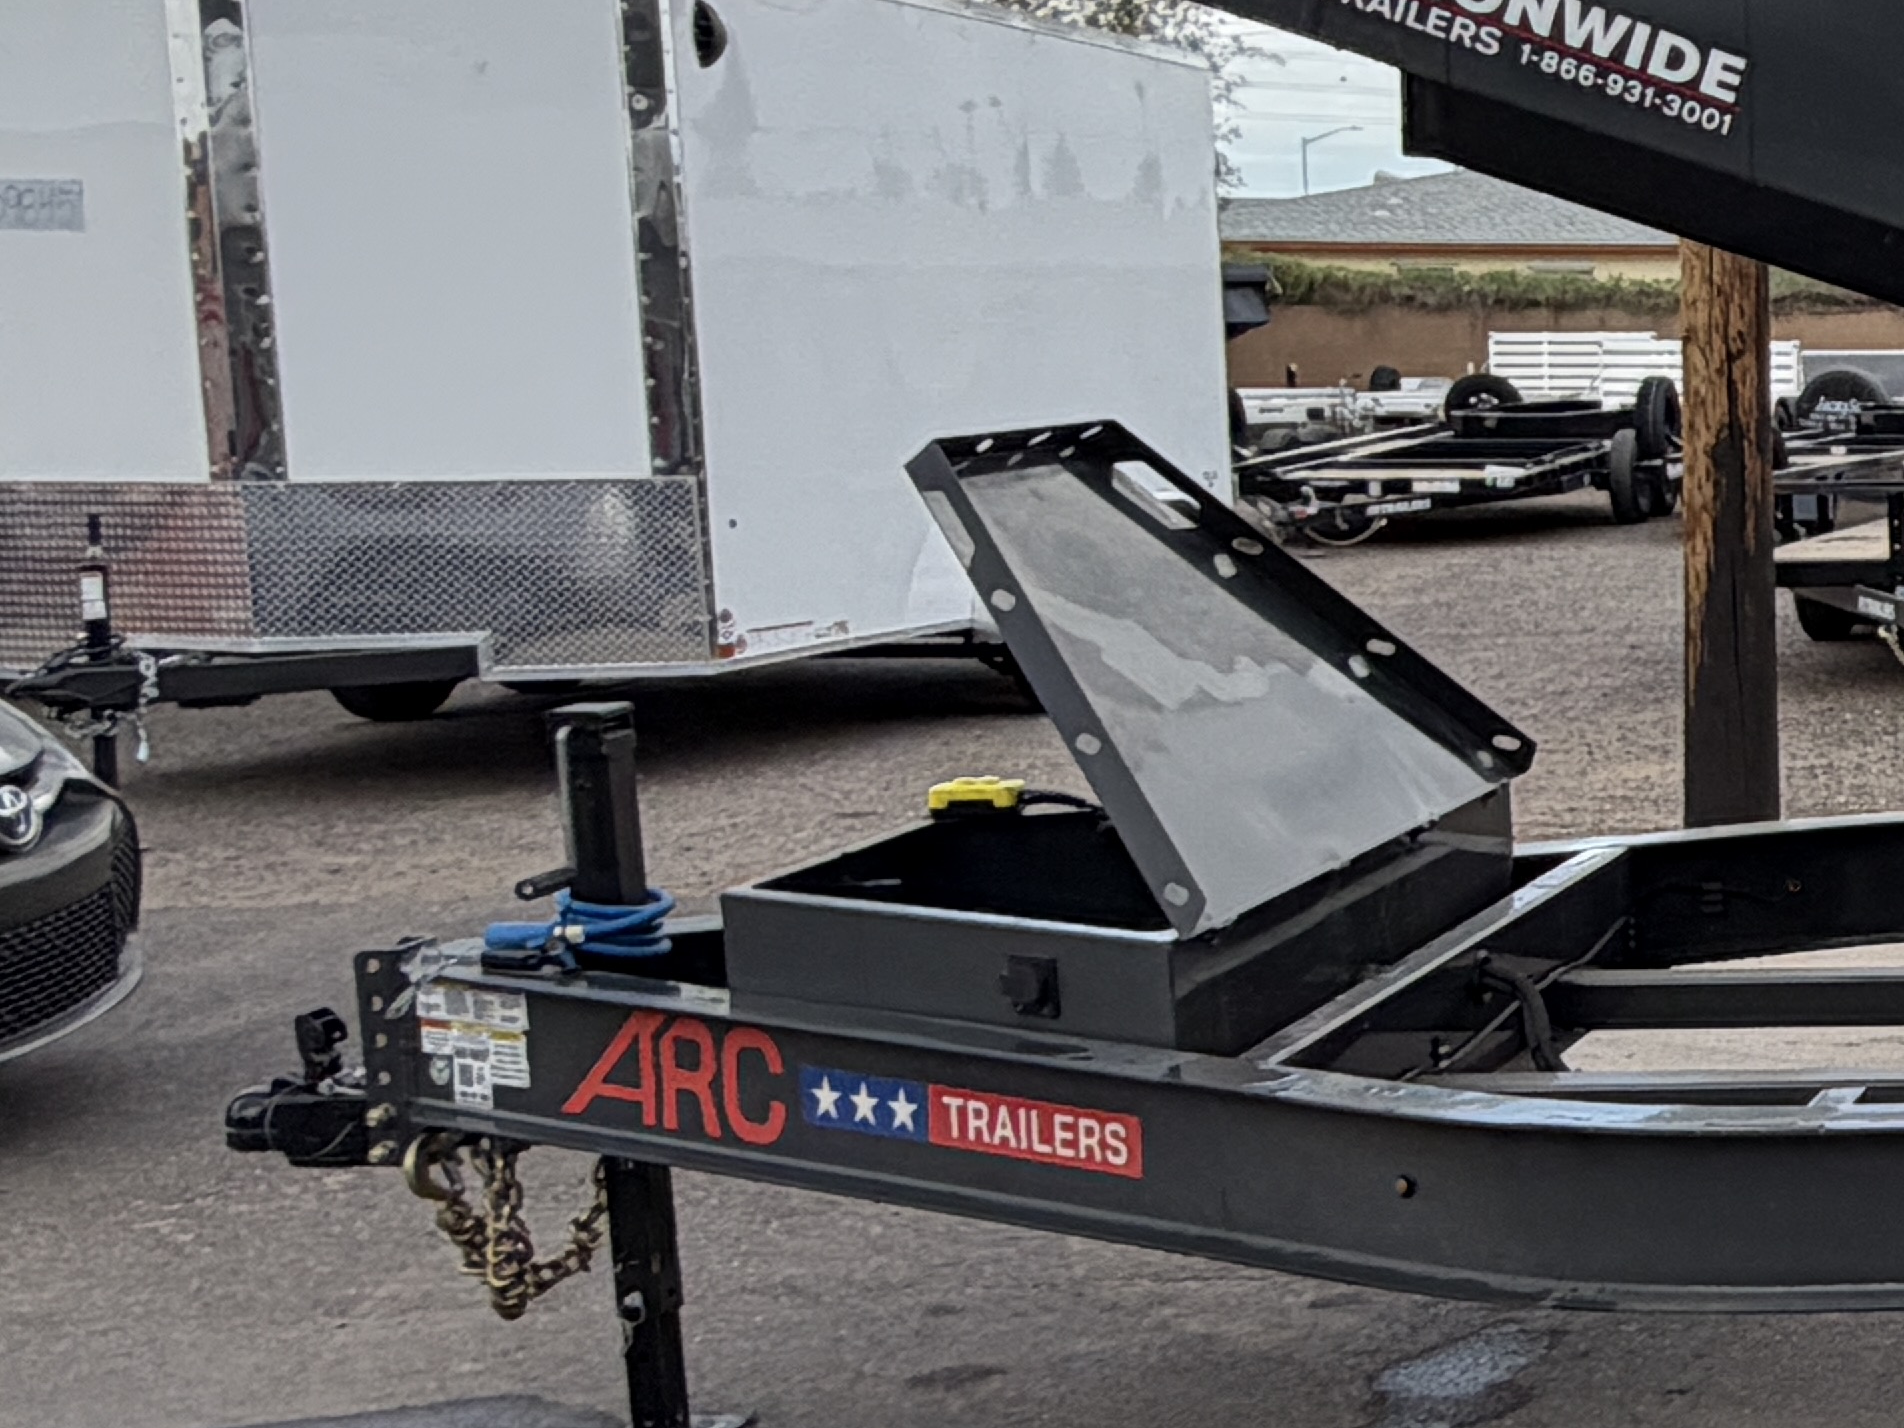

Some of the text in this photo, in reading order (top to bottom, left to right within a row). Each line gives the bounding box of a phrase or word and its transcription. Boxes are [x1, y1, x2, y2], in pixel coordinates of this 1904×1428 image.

[1520, 42, 1733, 136] 1-866-931-3001
[561, 1010, 787, 1145] ARC
[941, 1094, 1130, 1167] TRAILERS
